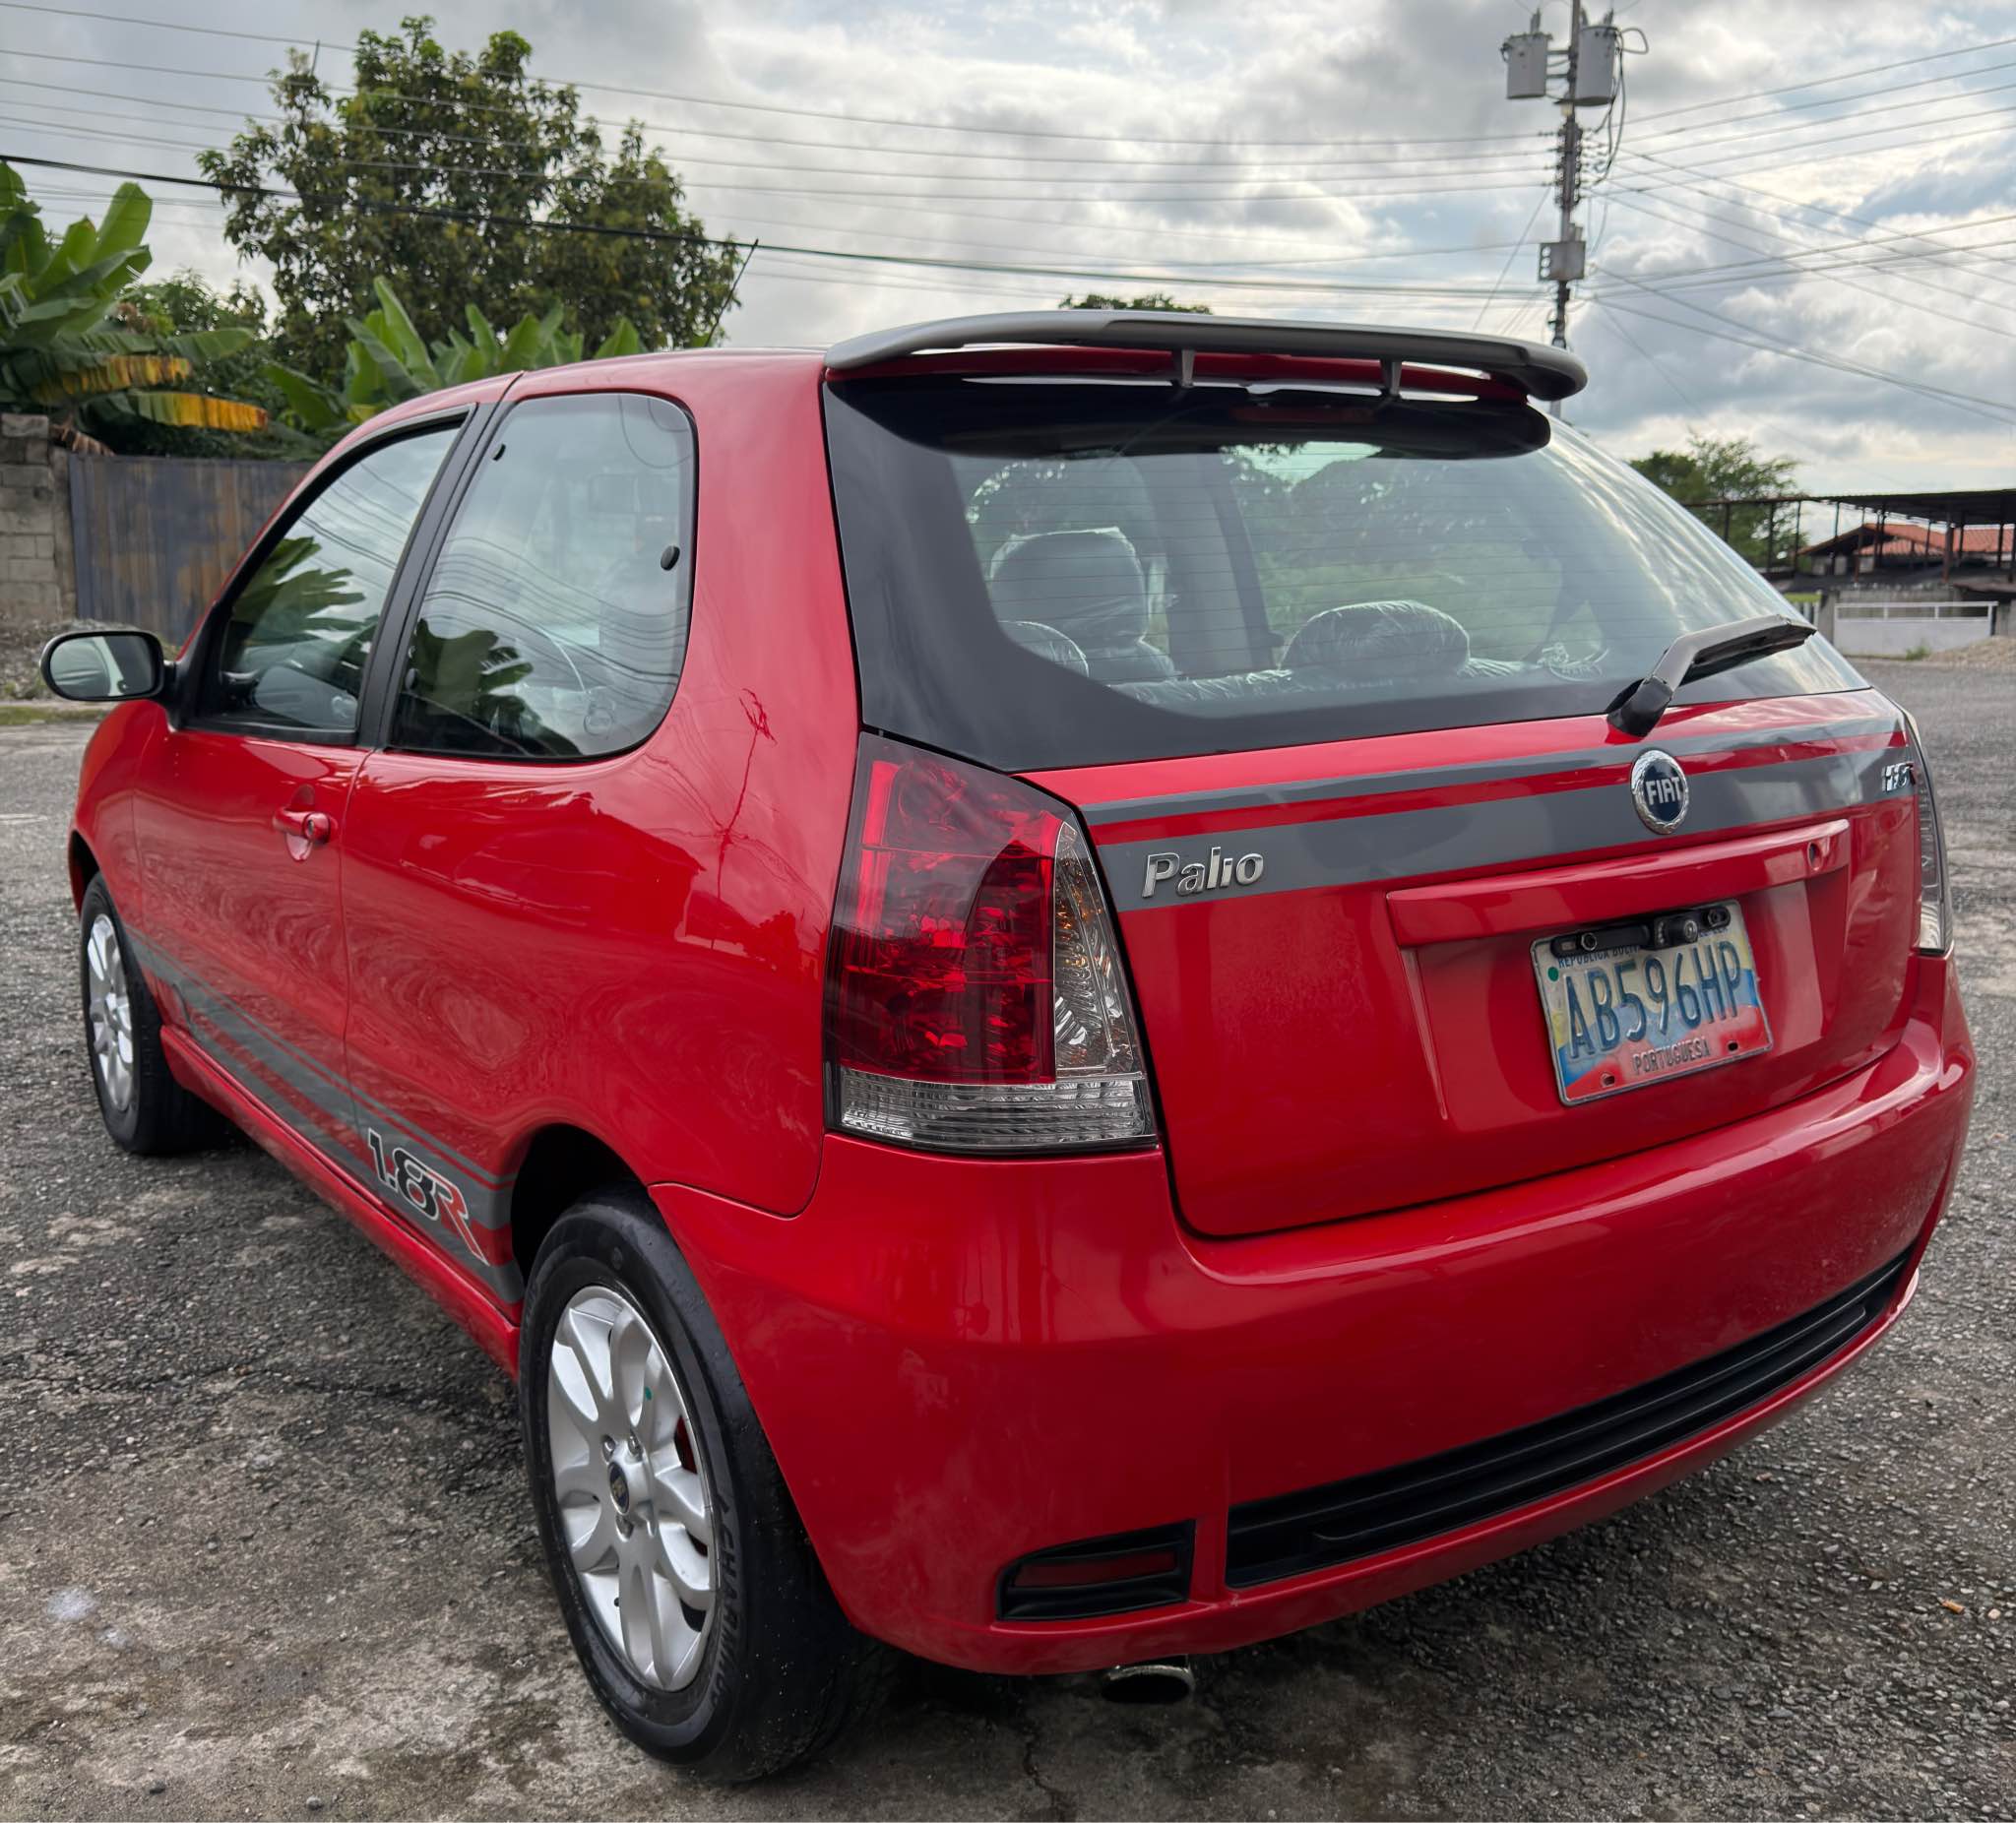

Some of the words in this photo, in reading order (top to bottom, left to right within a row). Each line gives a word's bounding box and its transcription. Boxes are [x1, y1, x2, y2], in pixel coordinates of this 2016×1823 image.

[1645, 777, 1681, 805] FIAT
[1142, 847, 1264, 899] Palio
[1563, 940, 1741, 1059] AB596HP
[1632, 1037, 1711, 1075] PORTUGUESA
[368, 1127, 490, 1267] 1.8R
